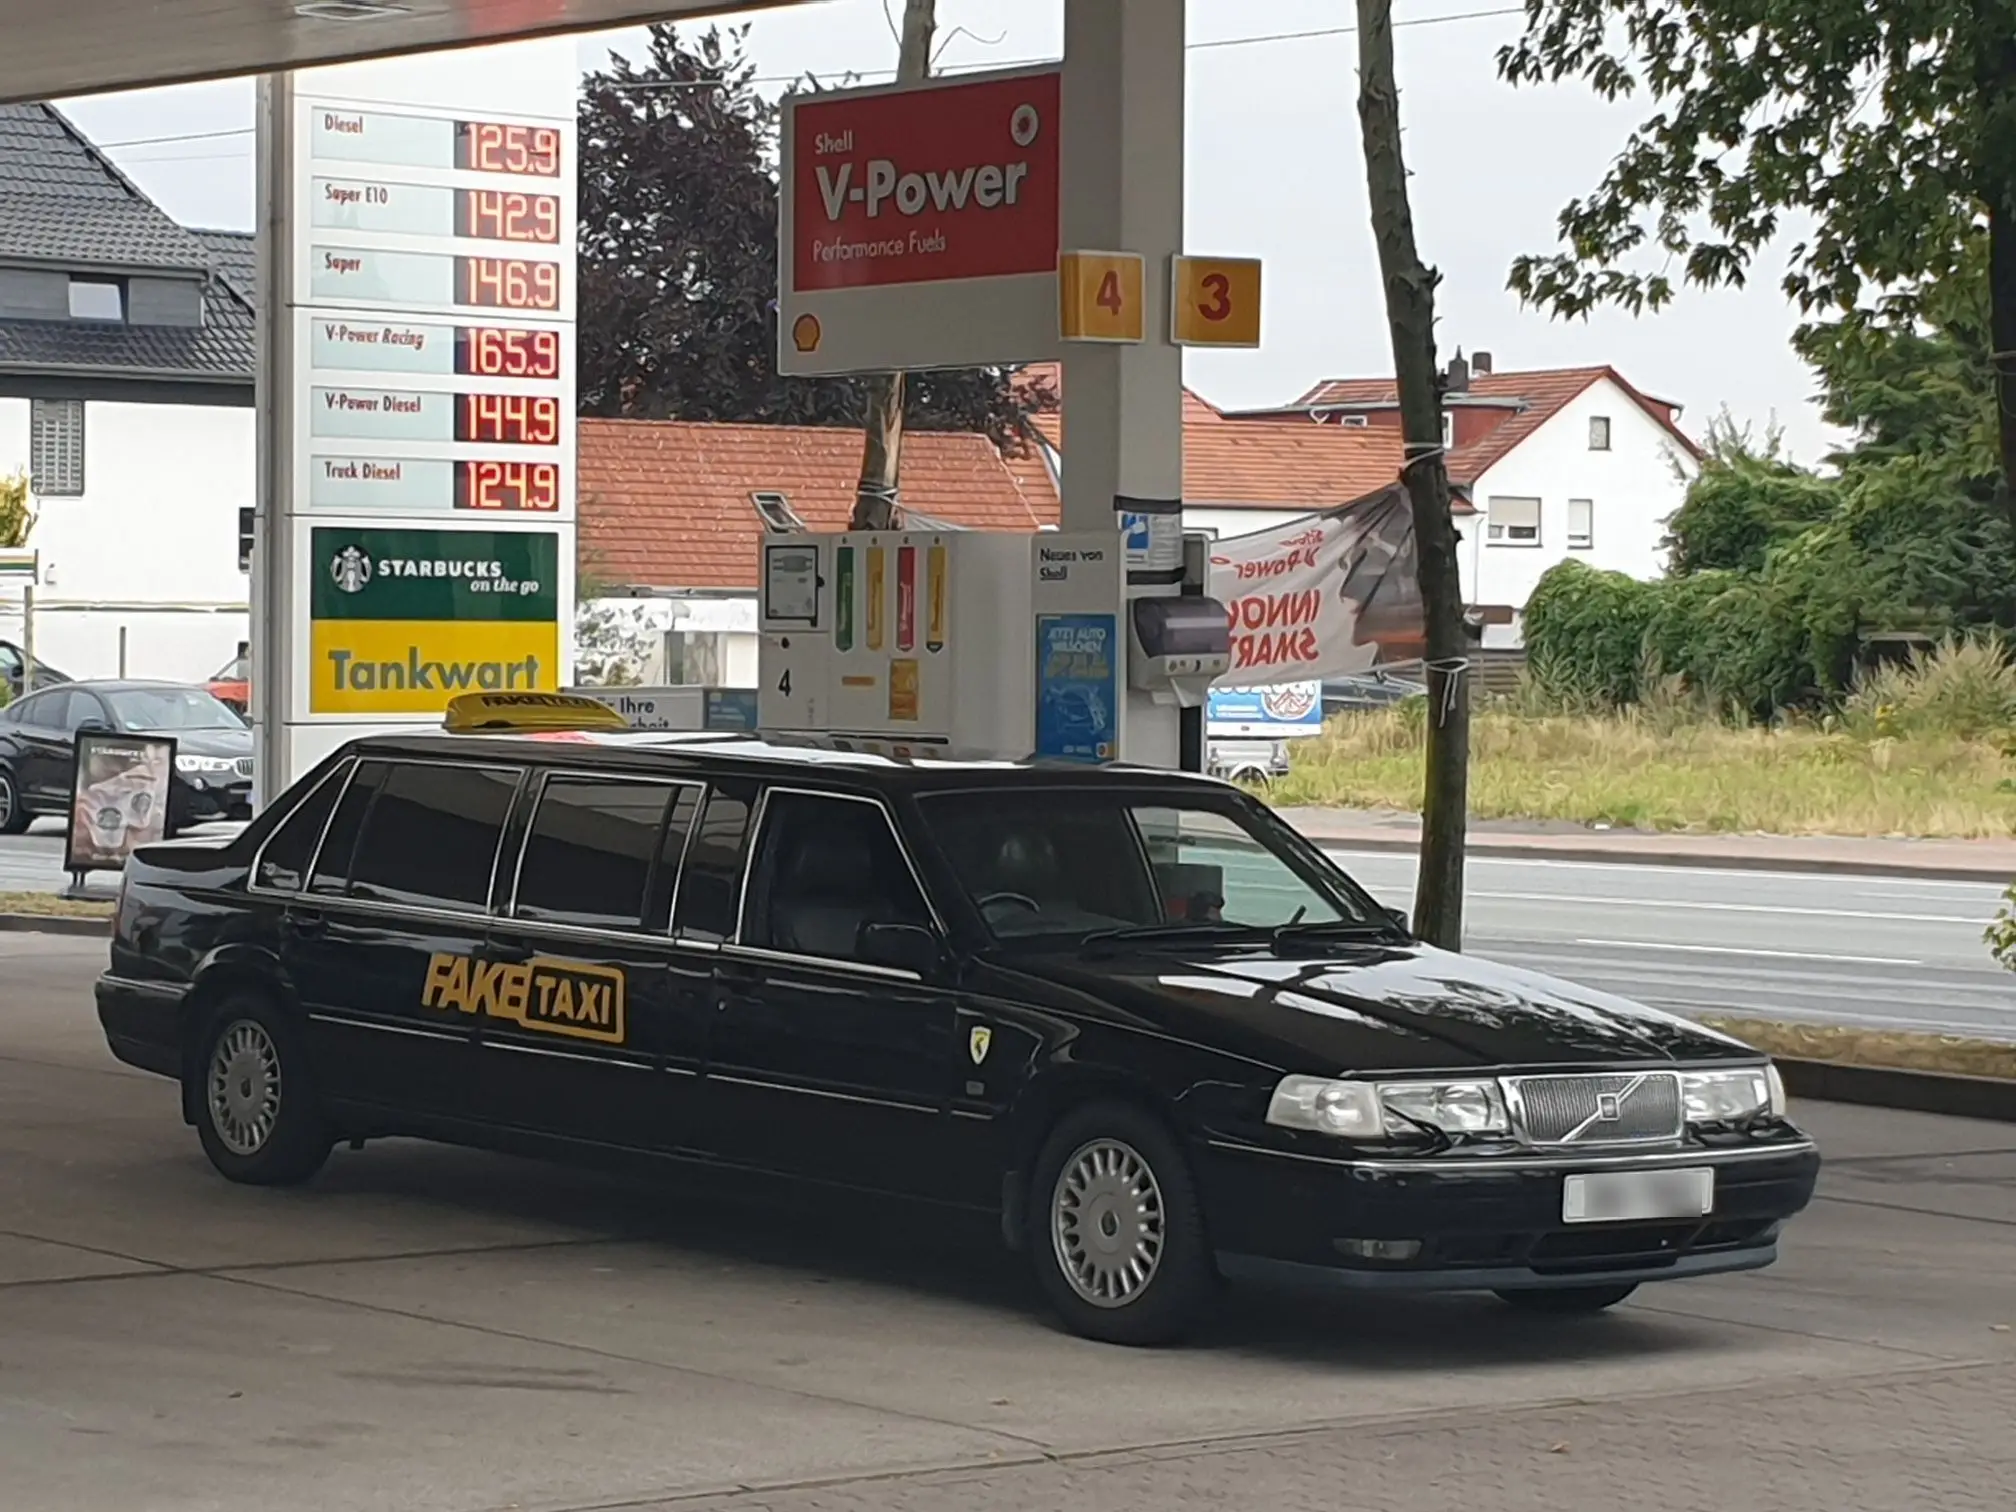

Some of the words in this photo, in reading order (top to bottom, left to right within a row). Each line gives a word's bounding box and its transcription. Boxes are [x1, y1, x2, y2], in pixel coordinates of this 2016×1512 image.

[324, 114, 363, 134] Diesel
[467, 122, 557, 173] 125.9
[814, 130, 853, 155] Shell
[324, 184, 361, 205] Super
[365, 187, 388, 205] E10
[814, 159, 1028, 222] V-Power
[468, 190, 557, 241] 142.9
[813, 236, 905, 262] Performance
[908, 228, 947, 254] Fuels
[324, 252, 361, 275] Super
[467, 257, 557, 308] 146.9
[1096, 270, 1122, 316] 4
[1197, 273, 1232, 321] 3
[325, 324, 378, 343] V-Power
[382, 328, 425, 351] Racing
[467, 327, 557, 376] 165.9
[325, 392, 378, 412] V-Power
[383, 395, 422, 413] Diesel
[467, 393, 557, 443] 144.9
[325, 461, 357, 479] Truck
[362, 462, 402, 481] Diesel
[466, 461, 556, 509] 124.9
[378, 559, 502, 577] STARBUCKS
[1080, 550, 1104, 561] von
[470, 580, 491, 592] on
[493, 577, 518, 592] the
[520, 580, 539, 595] go
[328, 646, 538, 690] Tankwart
[778, 668, 792, 697] 4
[421, 952, 529, 1019] FAKE
[534, 975, 611, 1025] TAXI
